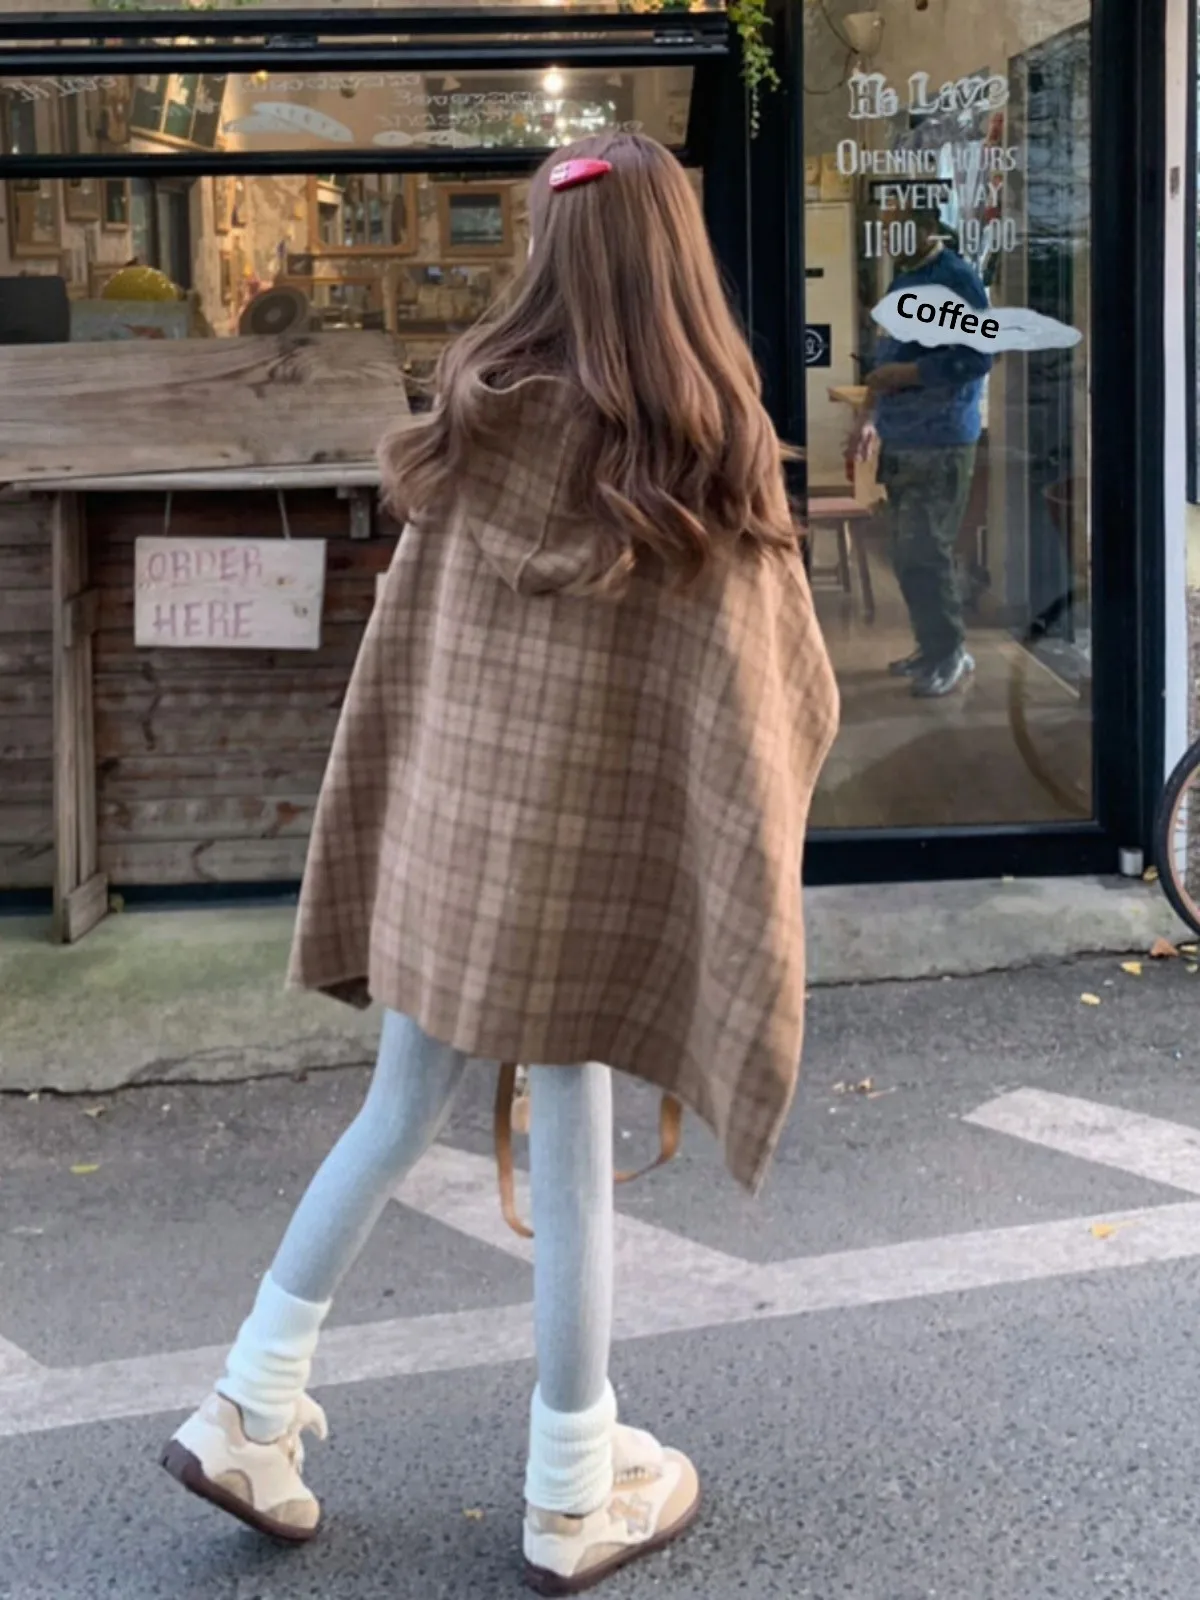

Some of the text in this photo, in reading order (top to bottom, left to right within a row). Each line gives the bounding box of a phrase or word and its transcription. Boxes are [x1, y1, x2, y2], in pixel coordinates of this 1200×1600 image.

[863, 220, 916, 258] 11:00
[896, 292, 1000, 339] Coffee
[147, 547, 263, 586] ORDER
[152, 600, 253, 639] HERE
